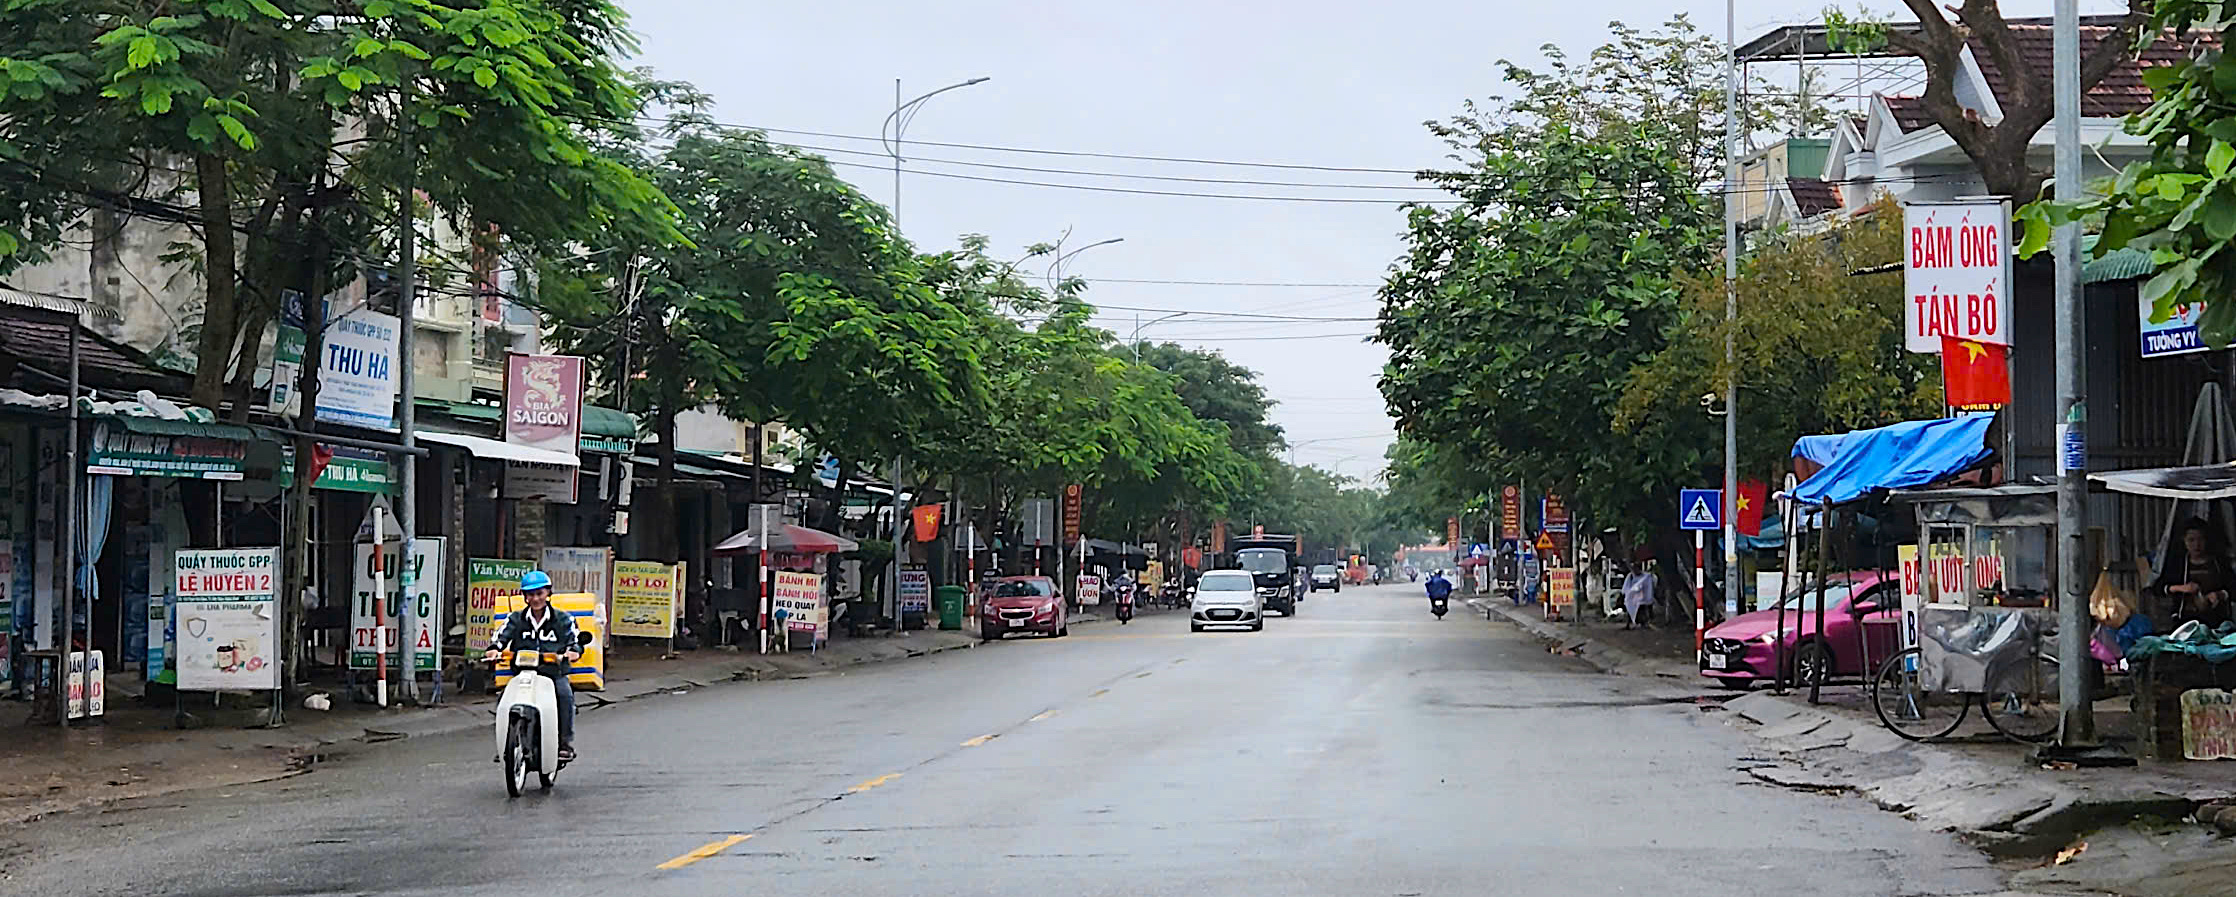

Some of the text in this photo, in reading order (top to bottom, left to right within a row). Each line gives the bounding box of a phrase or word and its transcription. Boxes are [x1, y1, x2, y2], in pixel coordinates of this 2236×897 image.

[1912, 210, 1998, 268] BẤM ỐNG
[1915, 278, 1997, 336] TÁN BỐ
[2182, 330, 2196, 347] VY
[329, 343, 388, 381] THU HÀ
[533, 402, 550, 410] BIA
[512, 410, 568, 425] SAIGON
[327, 464, 344, 481] THU
[210, 551, 245, 569] THUỐC
[249, 555, 270, 568] GPP
[260, 574, 270, 590] 2
[471, 582, 506, 609] CHÁ
[522, 629, 557, 641] FILA
